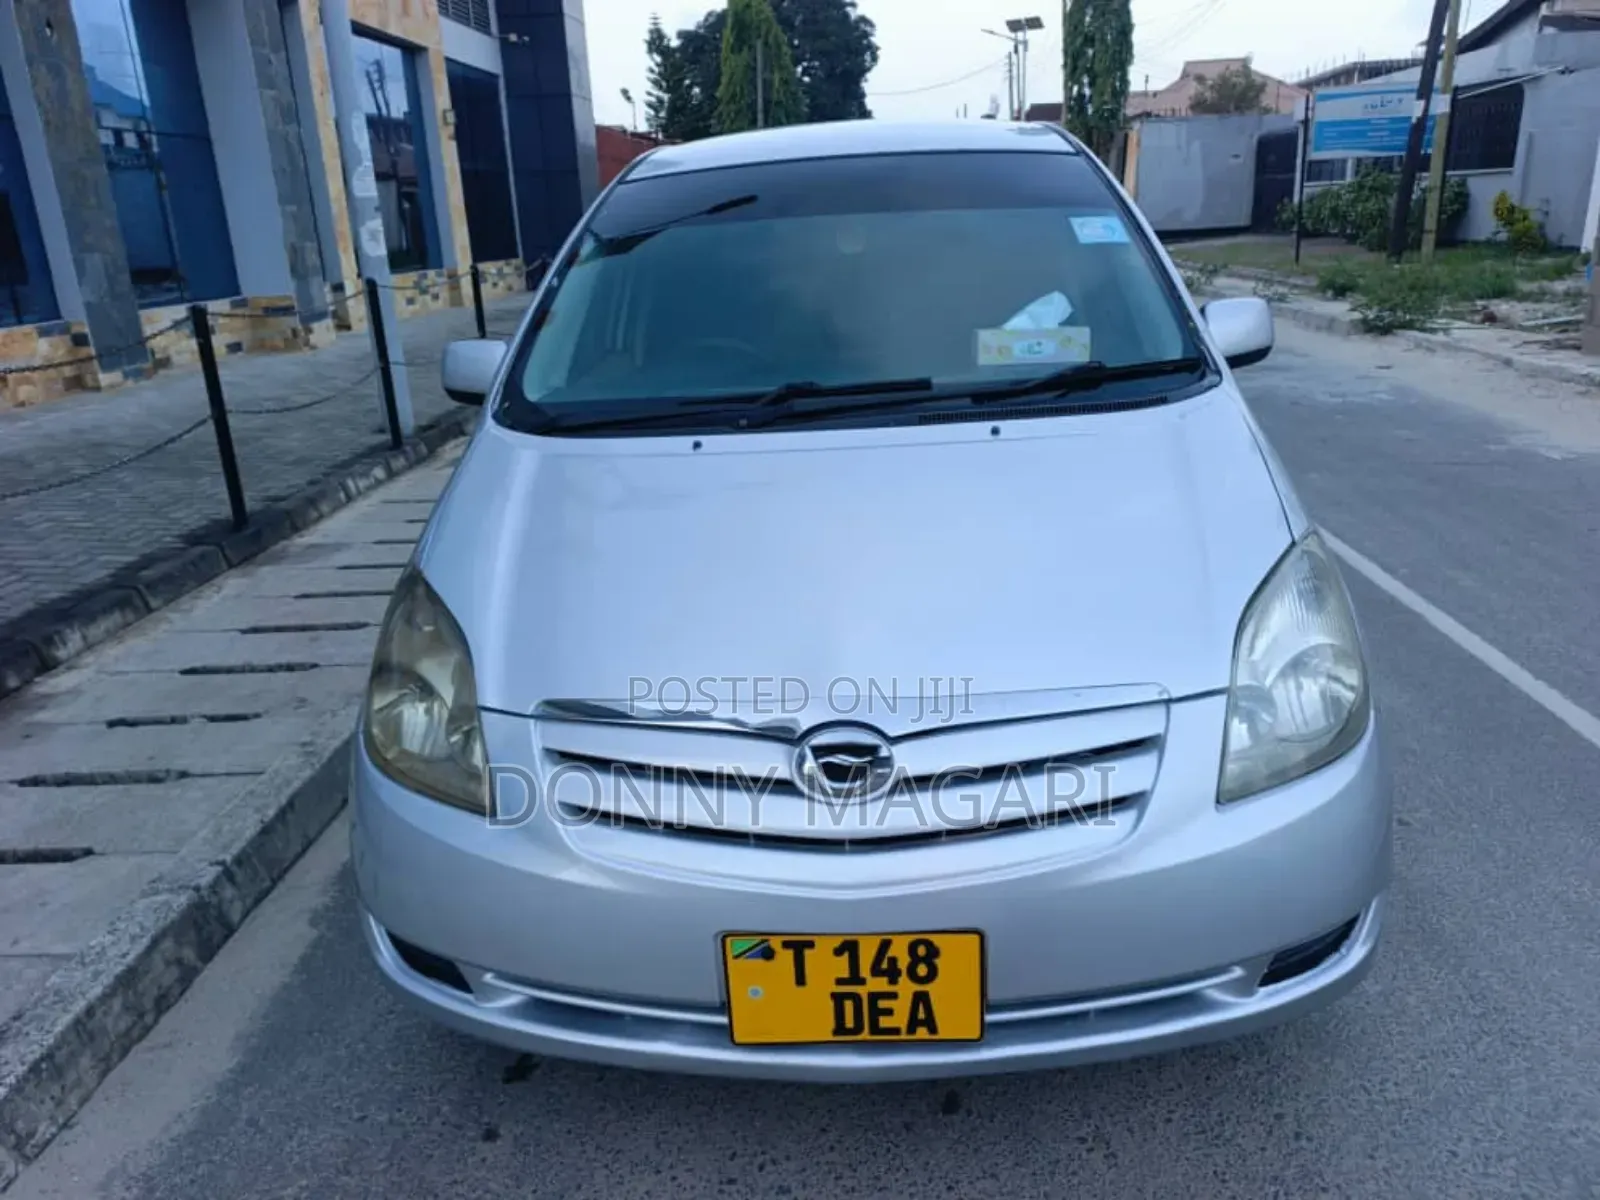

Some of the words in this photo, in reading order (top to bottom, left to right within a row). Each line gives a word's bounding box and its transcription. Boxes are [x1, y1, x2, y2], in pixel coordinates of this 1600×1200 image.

[781, 940, 816, 987] T
[832, 938, 941, 986] 148
[830, 990, 940, 1037] DEA
